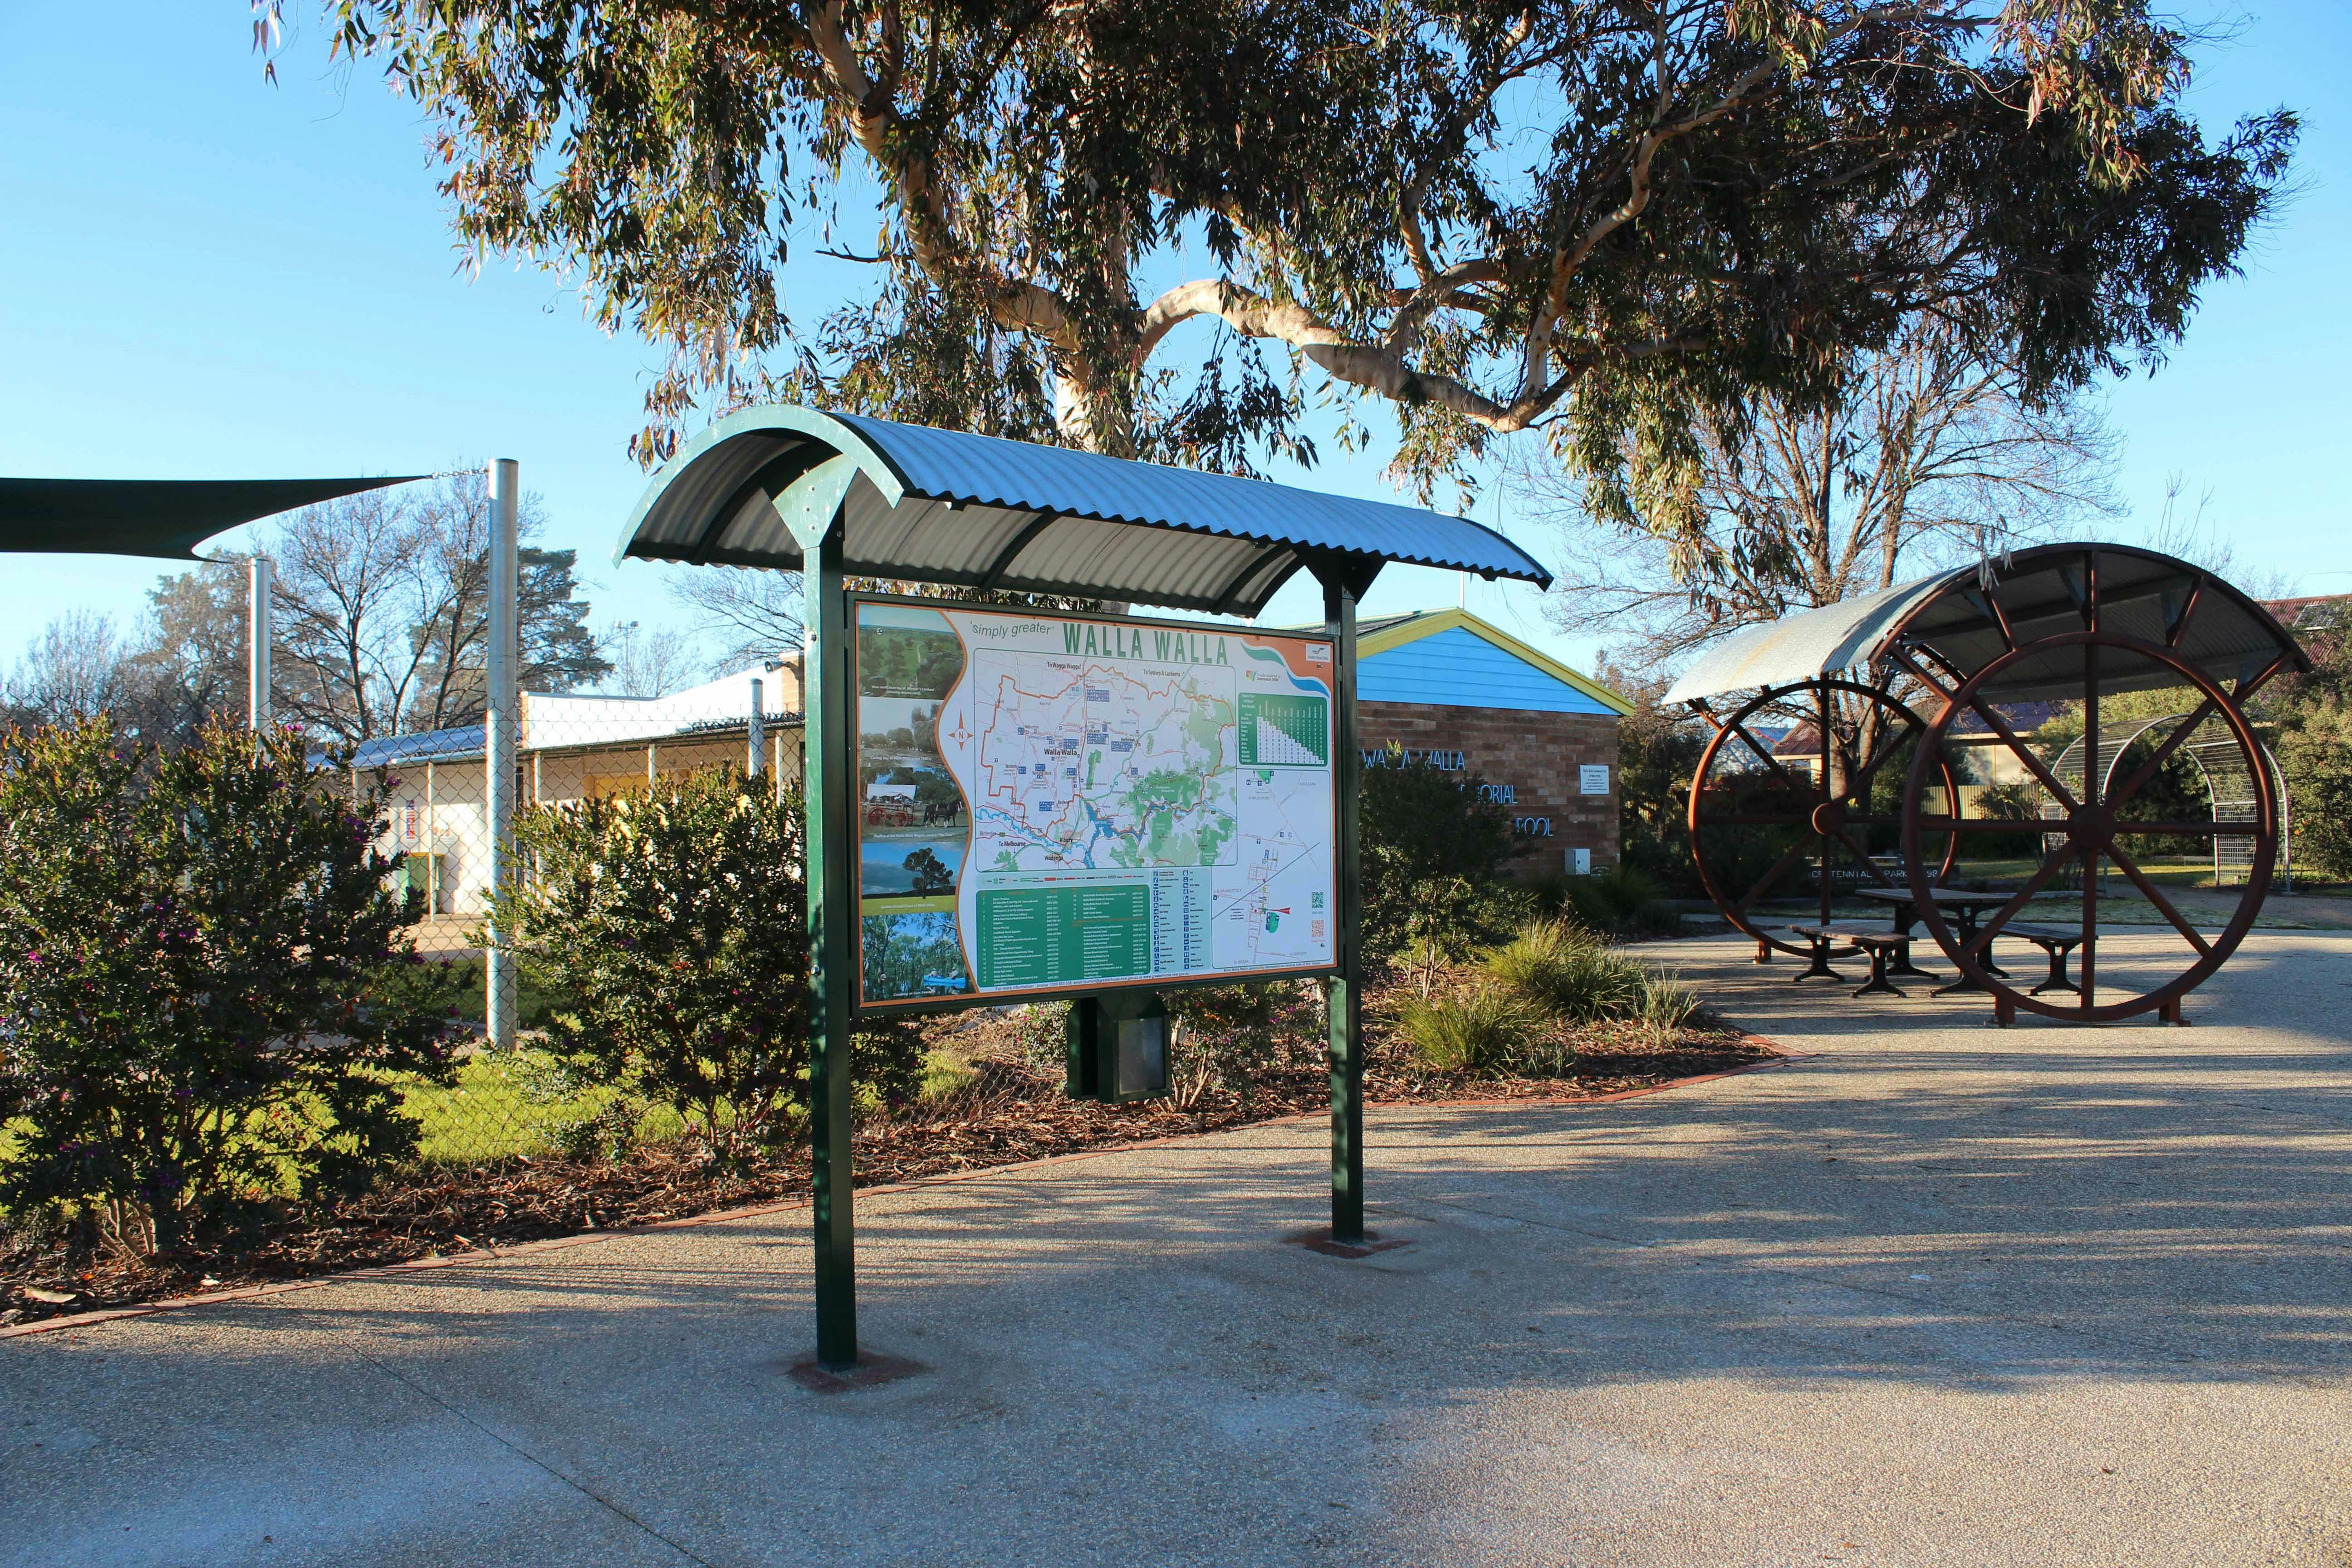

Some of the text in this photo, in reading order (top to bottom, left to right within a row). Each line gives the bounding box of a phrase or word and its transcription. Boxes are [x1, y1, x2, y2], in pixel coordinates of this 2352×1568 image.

[1063, 622, 1227, 665] WALLA WALLA
[959, 731, 964, 740] N
[1362, 749, 1410, 769] WAA
[1457, 784, 1518, 804] ORIAL
